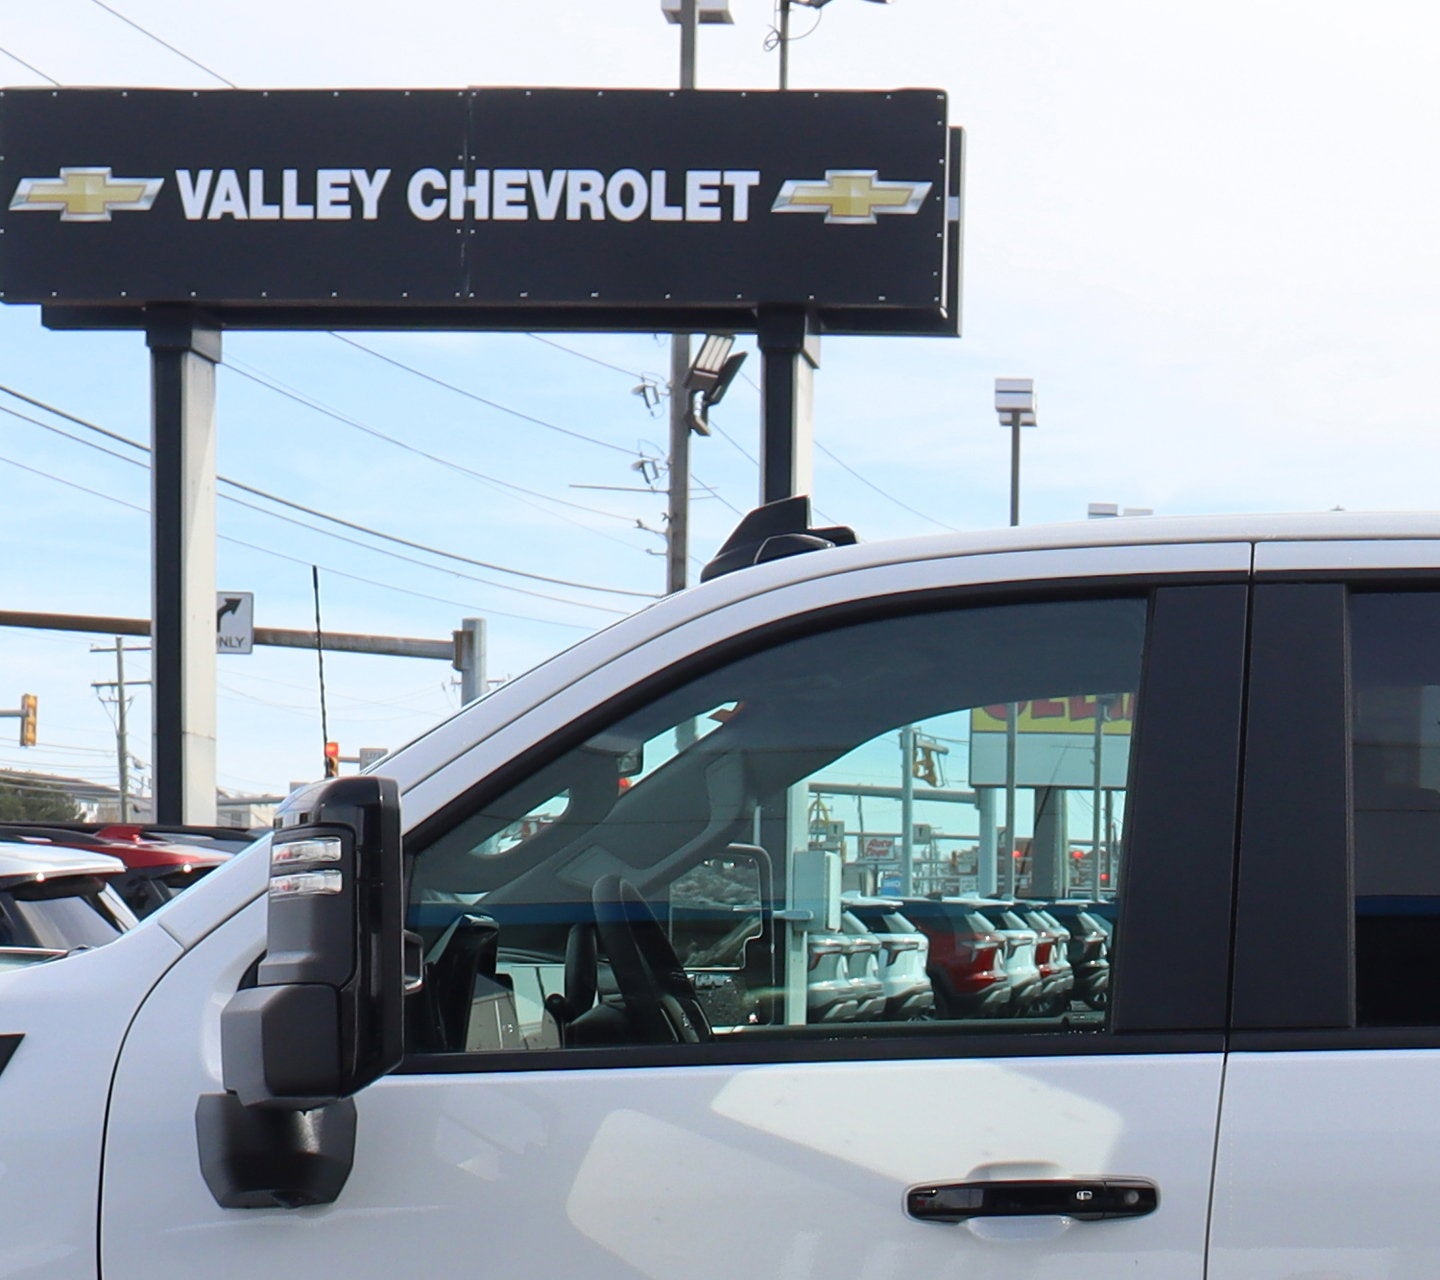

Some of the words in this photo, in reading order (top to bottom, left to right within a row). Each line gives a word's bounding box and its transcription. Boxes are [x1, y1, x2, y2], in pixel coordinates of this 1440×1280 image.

[175, 168, 391, 221] VALLEY
[407, 168, 760, 222] CHEVROLET
[217, 636, 245, 648] NLY
